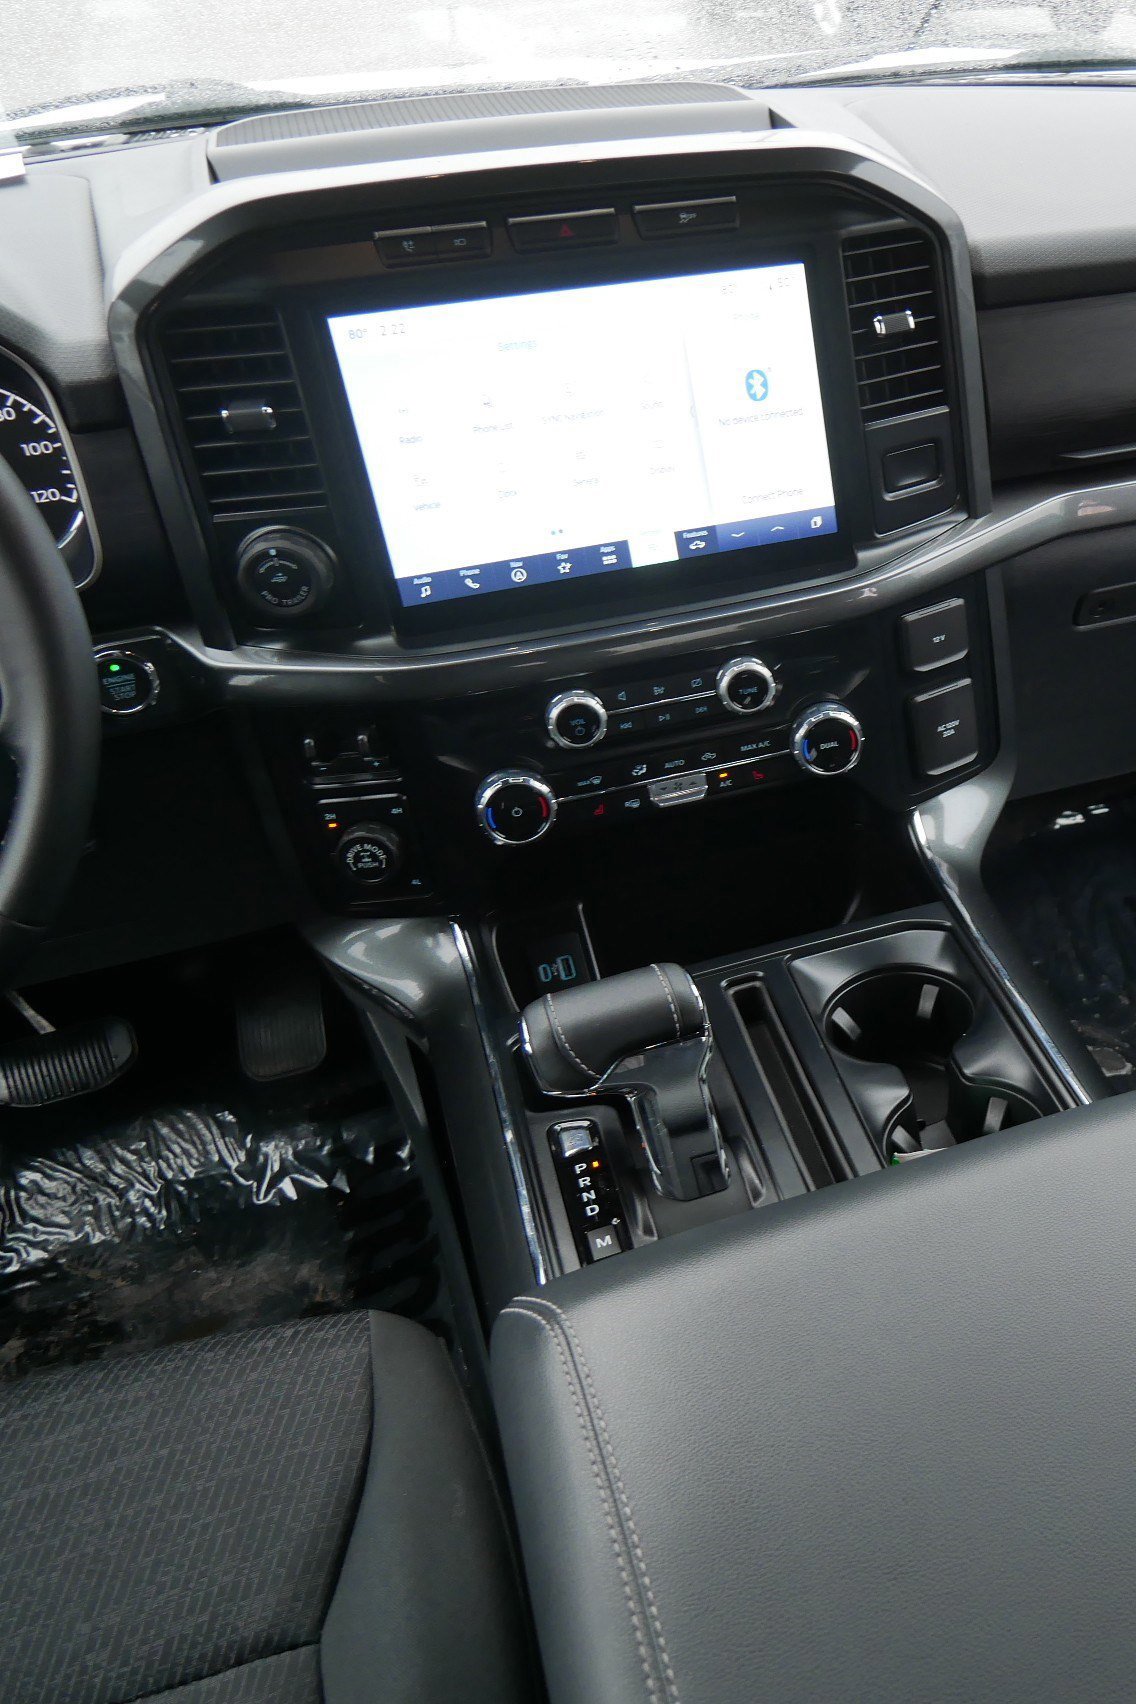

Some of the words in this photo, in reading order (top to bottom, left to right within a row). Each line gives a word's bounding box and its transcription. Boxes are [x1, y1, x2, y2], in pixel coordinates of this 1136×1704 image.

[20, 441, 53, 456] 100
[30, 488, 60, 503] 120
[819, 741, 839, 750] DUAL
[664, 759, 685, 769] AUTO
[346, 844, 363, 863] DRIVE
[574, 1163, 587, 1174] P
[578, 1176, 591, 1188] R
[581, 1190, 596, 1202] N
[585, 1204, 600, 1216] D
[595, 1234, 613, 1248] M
